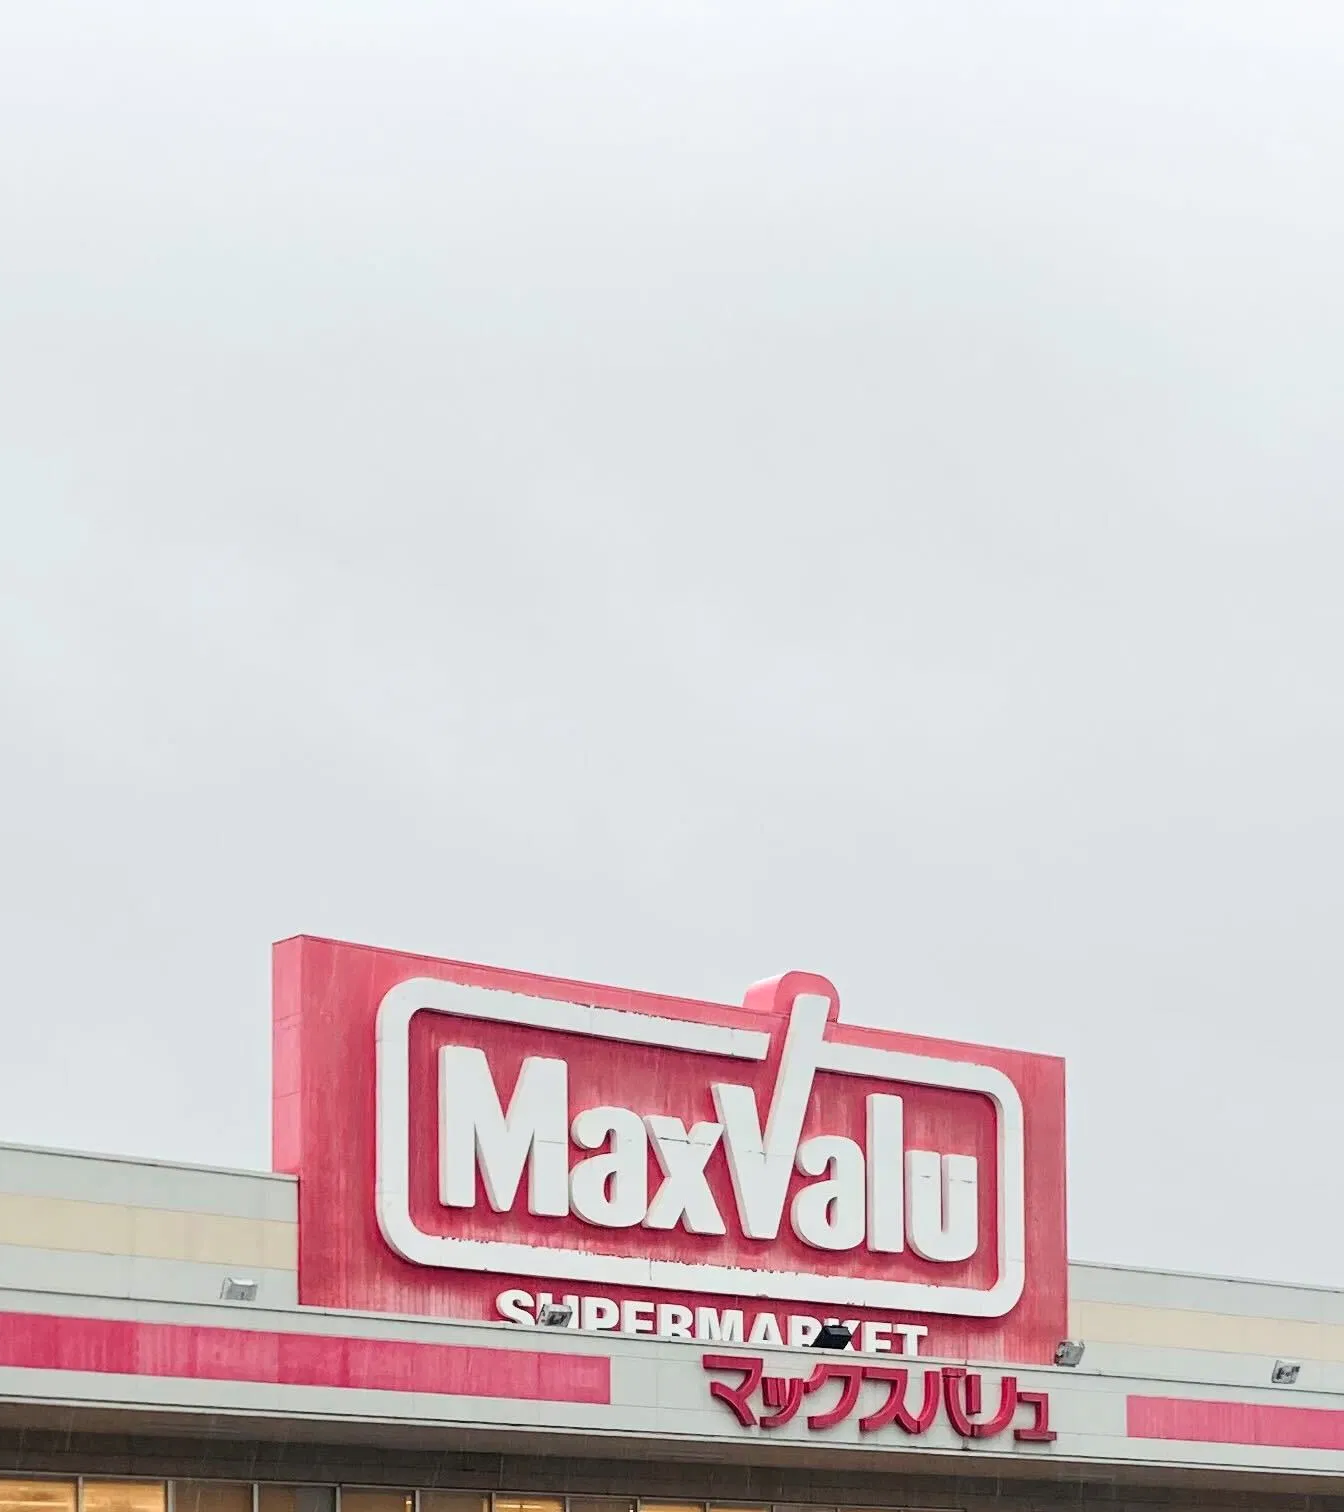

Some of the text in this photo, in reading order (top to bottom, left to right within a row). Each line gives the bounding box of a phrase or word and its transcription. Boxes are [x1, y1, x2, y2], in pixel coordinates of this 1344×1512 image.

[437, 993, 979, 1263] MaxValu
[702, 1353, 1057, 1441] マックスバリュ
